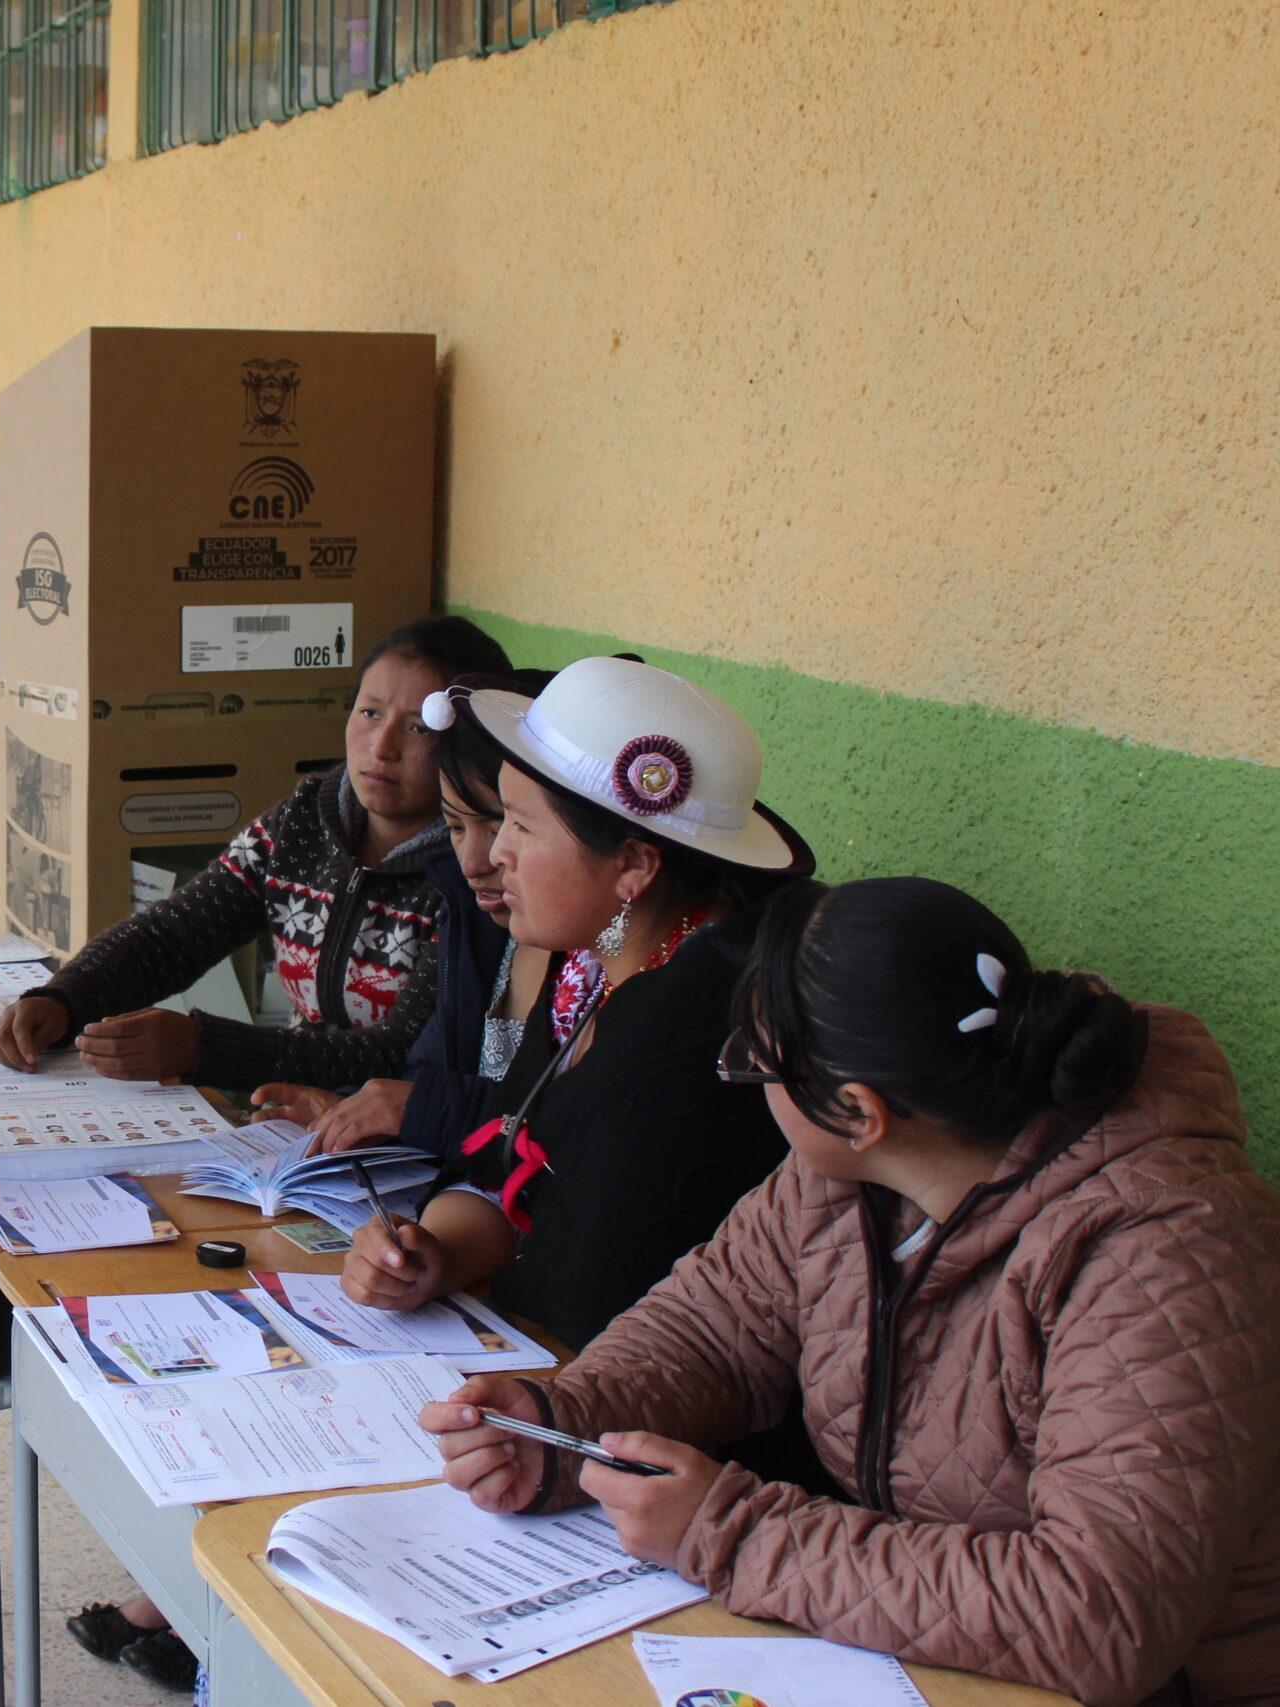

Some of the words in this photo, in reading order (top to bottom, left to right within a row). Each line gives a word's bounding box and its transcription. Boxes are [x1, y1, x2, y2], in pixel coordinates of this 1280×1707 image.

[204, 538, 271, 550] ECUADOR
[202, 553, 242, 566] ELIGE
[243, 553, 273, 565] CON
[309, 546, 357, 567] 2017
[35, 569, 52, 588] ISO
[179, 567, 296, 580] TRANSPARENCIA
[25, 587, 61, 604] ELECTORAL
[294, 646, 331, 667] 0026
